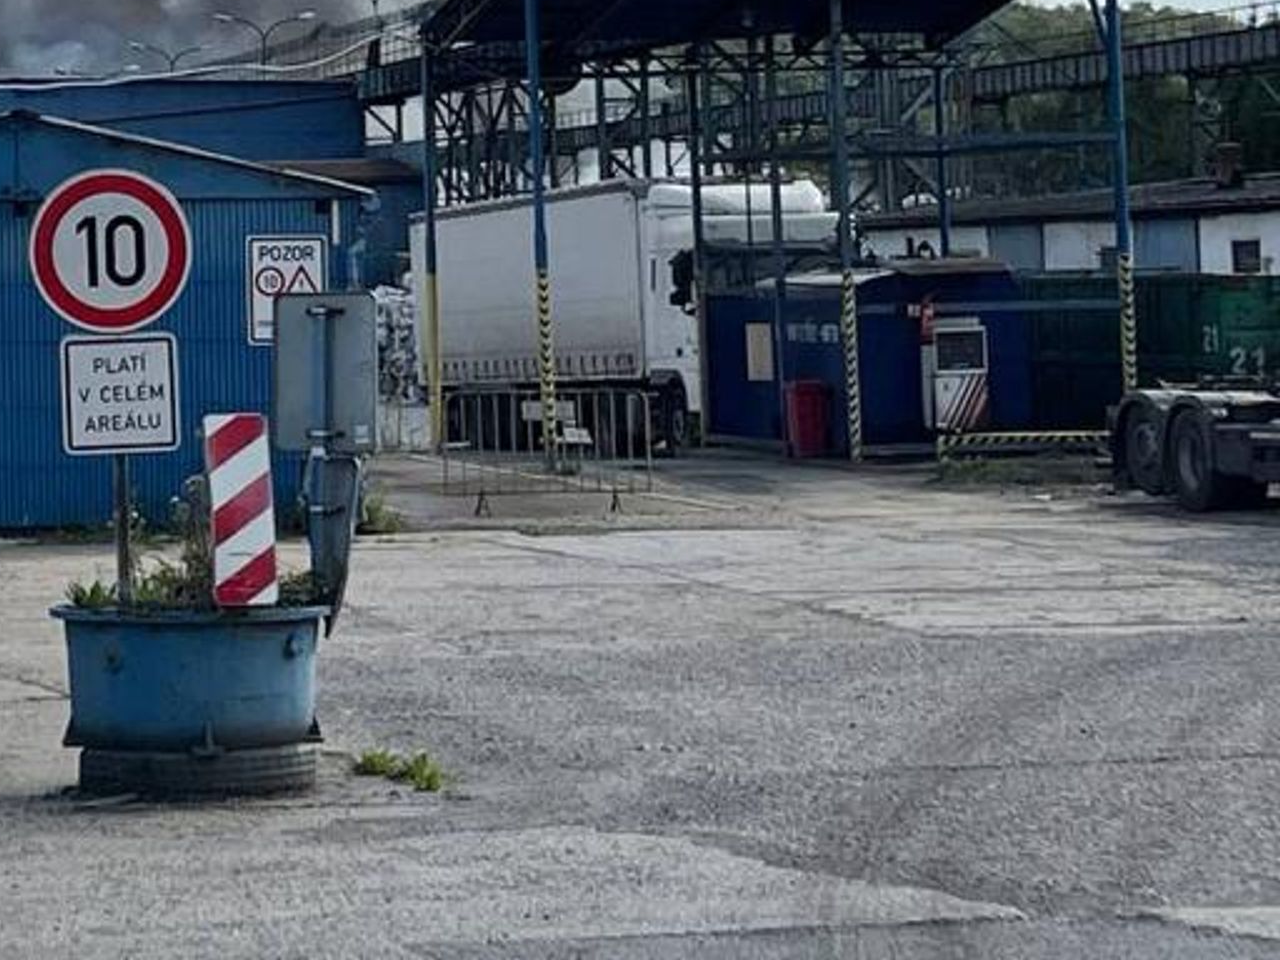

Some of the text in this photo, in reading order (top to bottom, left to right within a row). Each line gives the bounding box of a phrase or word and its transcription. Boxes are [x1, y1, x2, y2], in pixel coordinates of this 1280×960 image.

[75, 214, 146, 287] 10
[258, 245, 314, 261] POZOR
[92, 352, 146, 374] PLATÍ
[1229, 346, 1265, 374] 21
[79, 380, 165, 403] V CELÉM
[84, 408, 162, 433] AREÁLU
